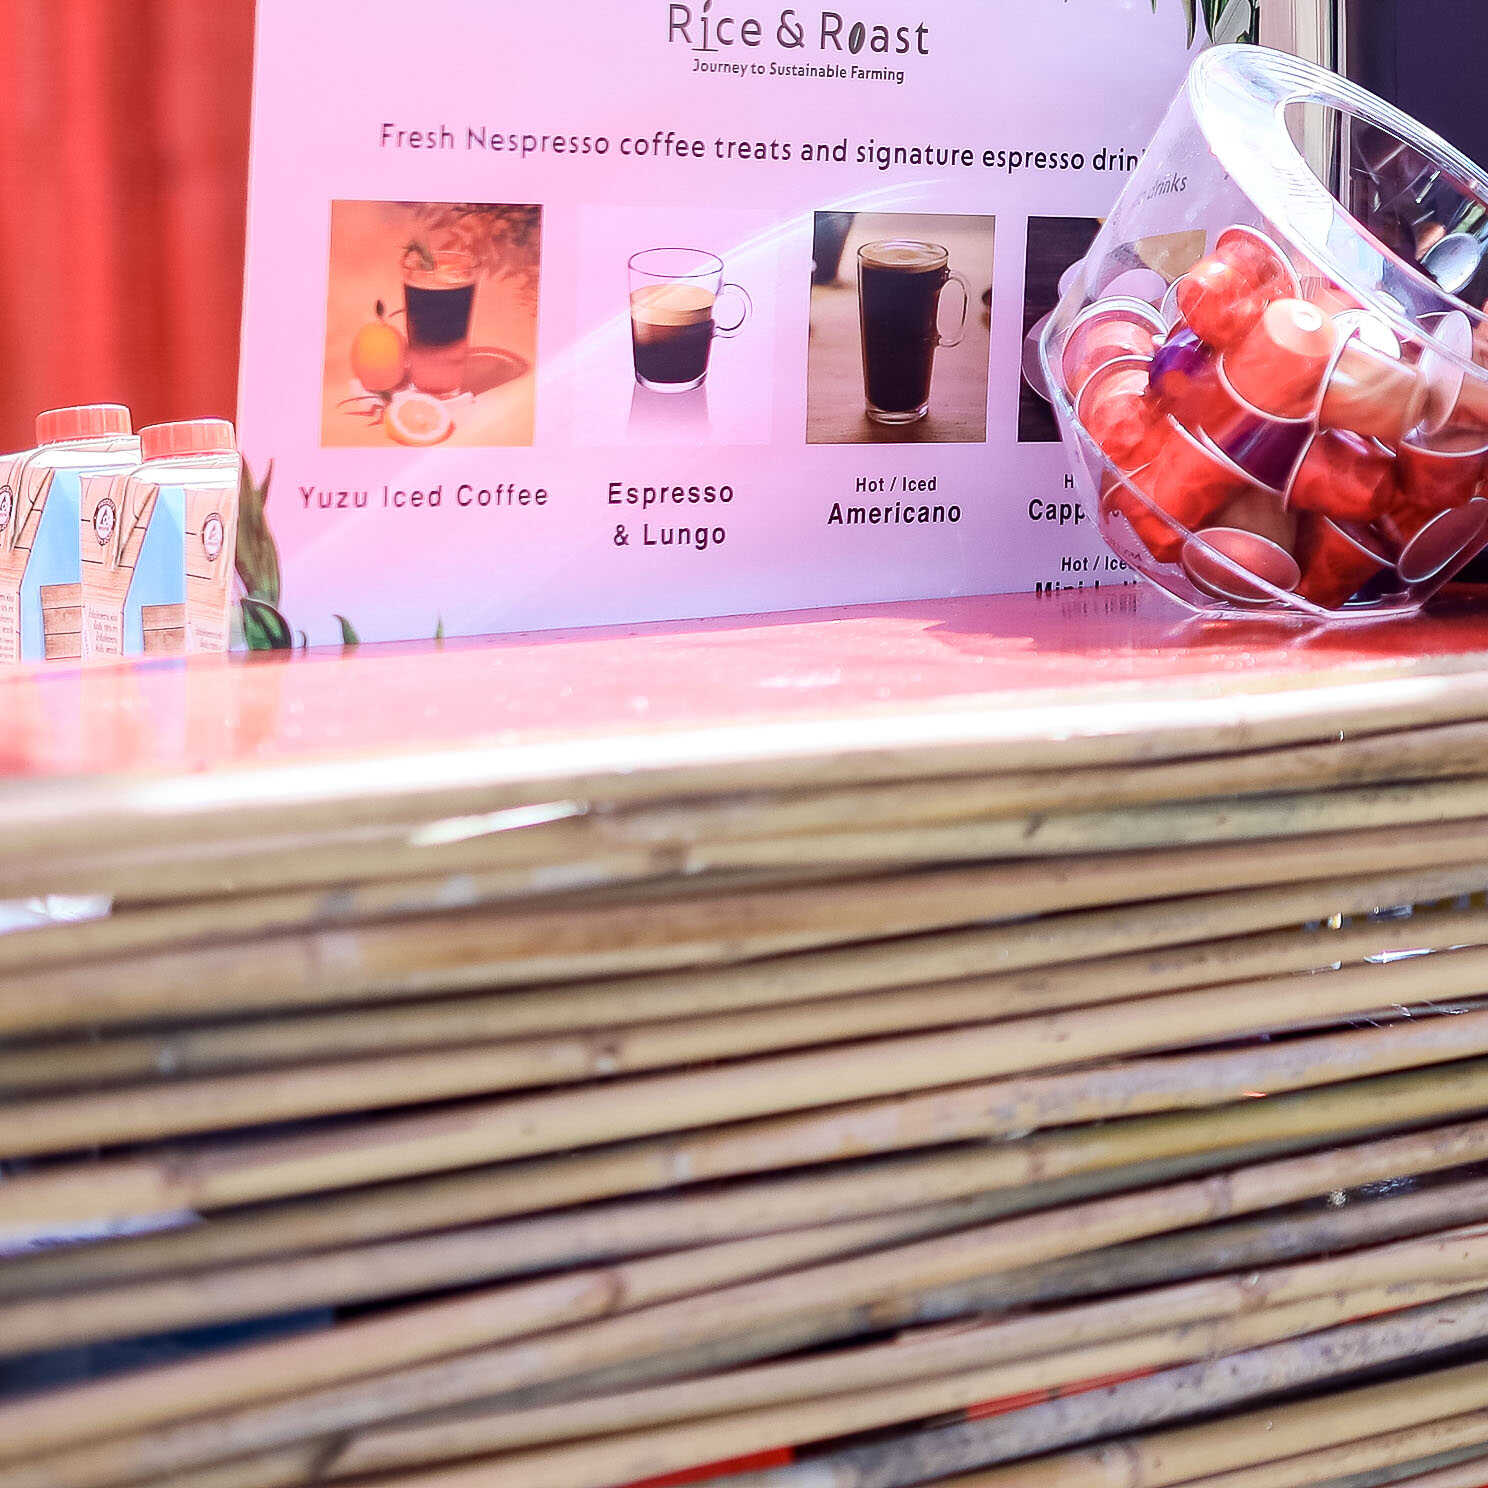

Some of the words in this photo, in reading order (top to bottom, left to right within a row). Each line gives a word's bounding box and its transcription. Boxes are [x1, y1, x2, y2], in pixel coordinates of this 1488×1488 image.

[669, 0, 761, 51] Rice
[777, 10, 804, 48] &
[820, 12, 928, 54] Roast
[693, 59, 748, 77] Journey
[751, 63, 766, 75] to
[770, 62, 846, 78] Sustainable
[851, 66, 904, 84] Farming
[382, 123, 453, 148] Fresh
[468, 127, 609, 158] Nespresso
[621, 131, 705, 157] coffee
[715, 138, 791, 160] treats
[801, 139, 847, 161] and
[857, 139, 973, 170] signature
[983, 150, 1084, 174] espresso
[1093, 148, 1145, 171] drin
[299, 487, 367, 508] Yuzu
[385, 485, 442, 507] Iced
[457, 484, 547, 506] Coffee
[609, 483, 733, 509] Espresso
[856, 478, 884, 492] Hot
[903, 477, 936, 491] Iced
[828, 502, 963, 524] Americano
[614, 525, 629, 546] &
[644, 524, 725, 550] Lungo
[1062, 557, 1088, 571] Hot
